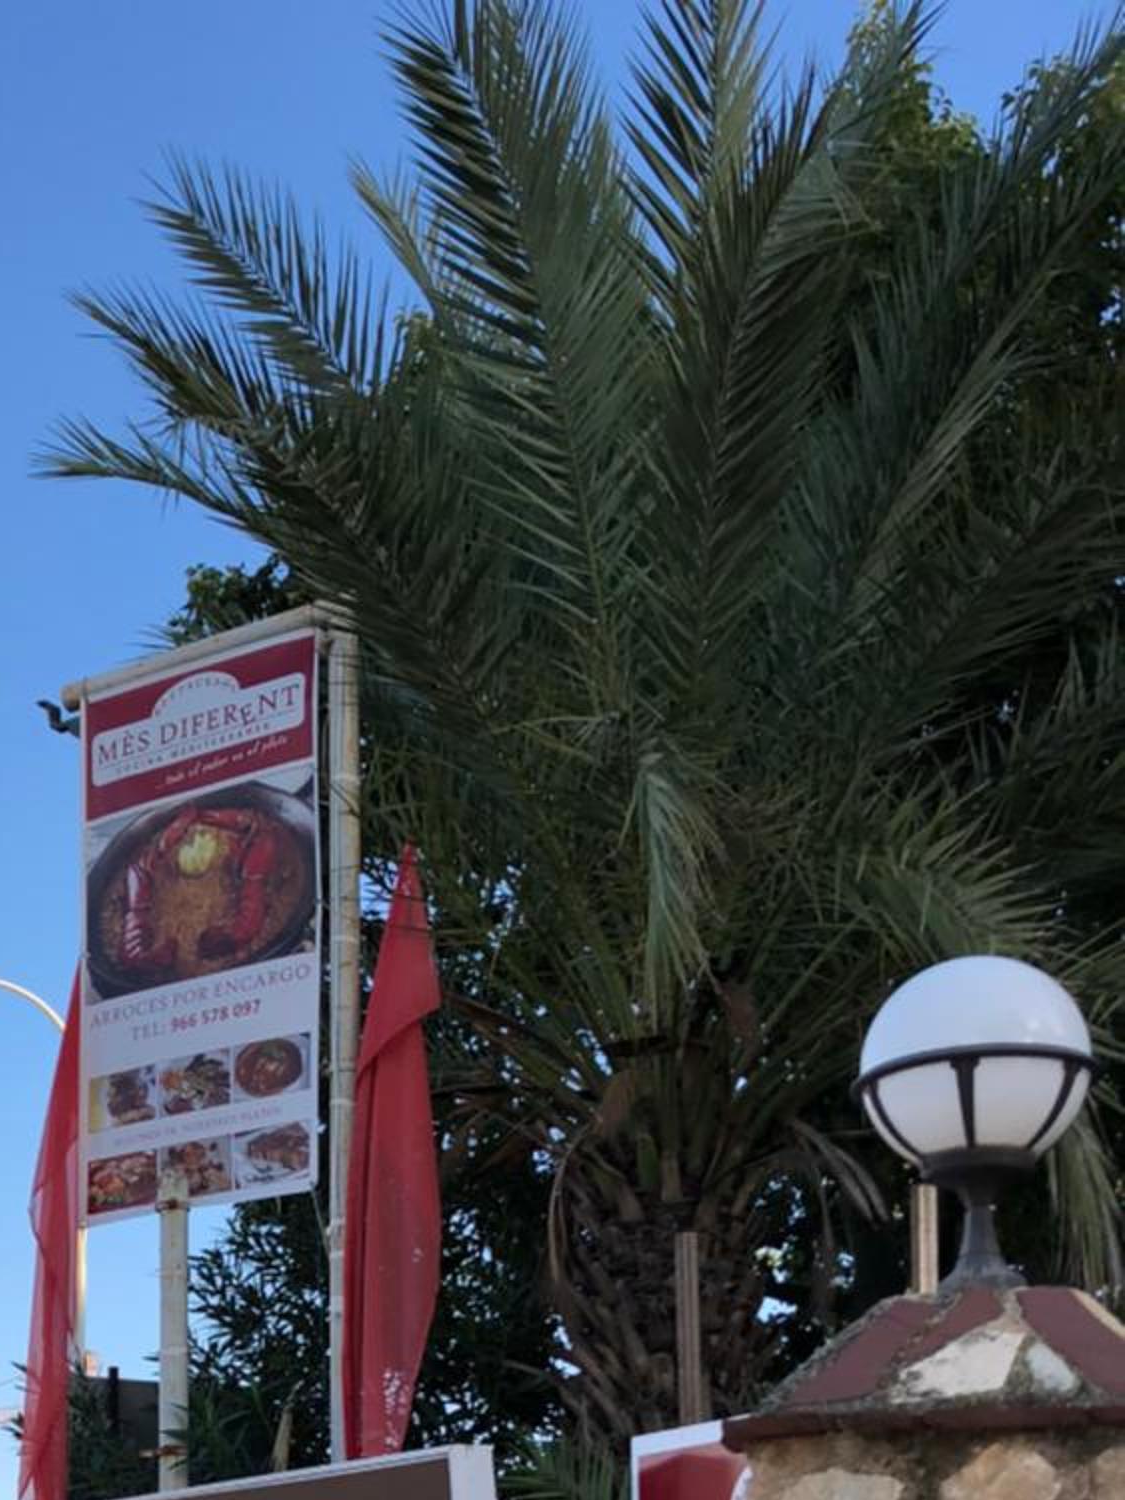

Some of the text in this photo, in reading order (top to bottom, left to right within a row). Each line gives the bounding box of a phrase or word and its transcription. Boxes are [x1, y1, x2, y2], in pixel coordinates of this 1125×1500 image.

[97, 683, 300, 766] MÈS DIFERENT
[89, 962, 312, 1030] ARROCES POR ENCARGO
